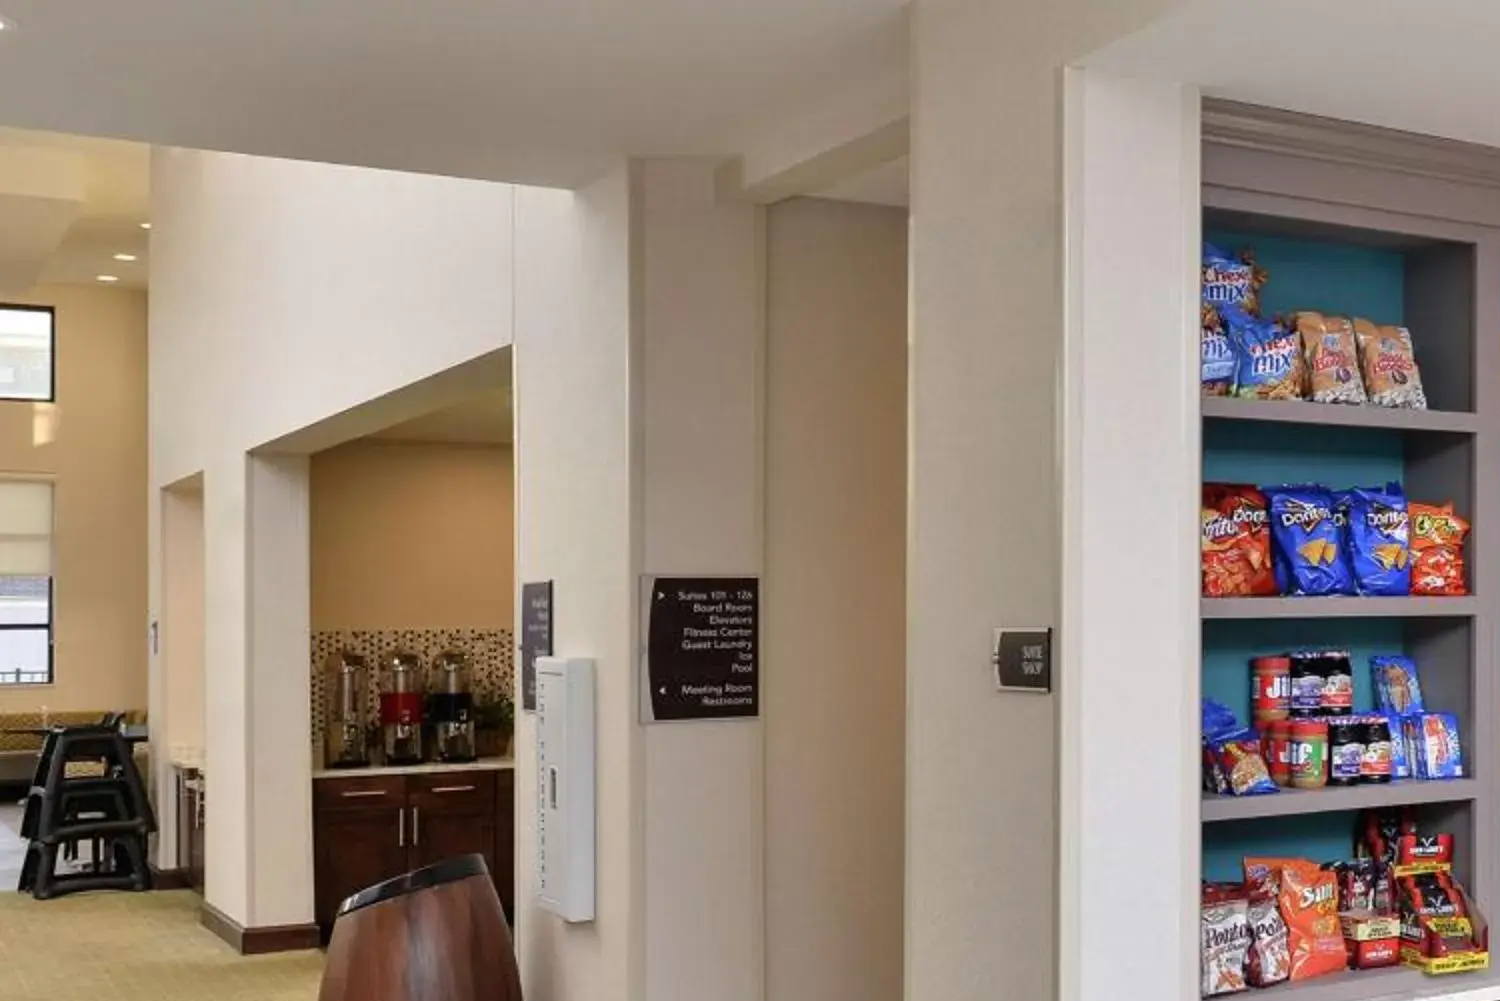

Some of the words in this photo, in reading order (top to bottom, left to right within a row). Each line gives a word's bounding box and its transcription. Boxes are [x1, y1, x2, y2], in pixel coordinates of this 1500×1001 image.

[1252, 354, 1293, 375] mix
[678, 591, 707, 601] Suites
[693, 603, 723, 613] Board
[725, 603, 752, 612] Room
[709, 615, 752, 625] Elevators
[683, 627, 718, 637] Fitness
[720, 627, 752, 637] Center
[681, 640, 711, 650] Guest
[714, 640, 752, 651] Laundry
[731, 662, 752, 673] Pool
[682, 685, 722, 696] Meeting
[725, 683, 752, 693] Room
[1266, 675, 1291, 699] Ji
[702, 695, 752, 705] Restrooms
[1279, 740, 1313, 764] Jif
